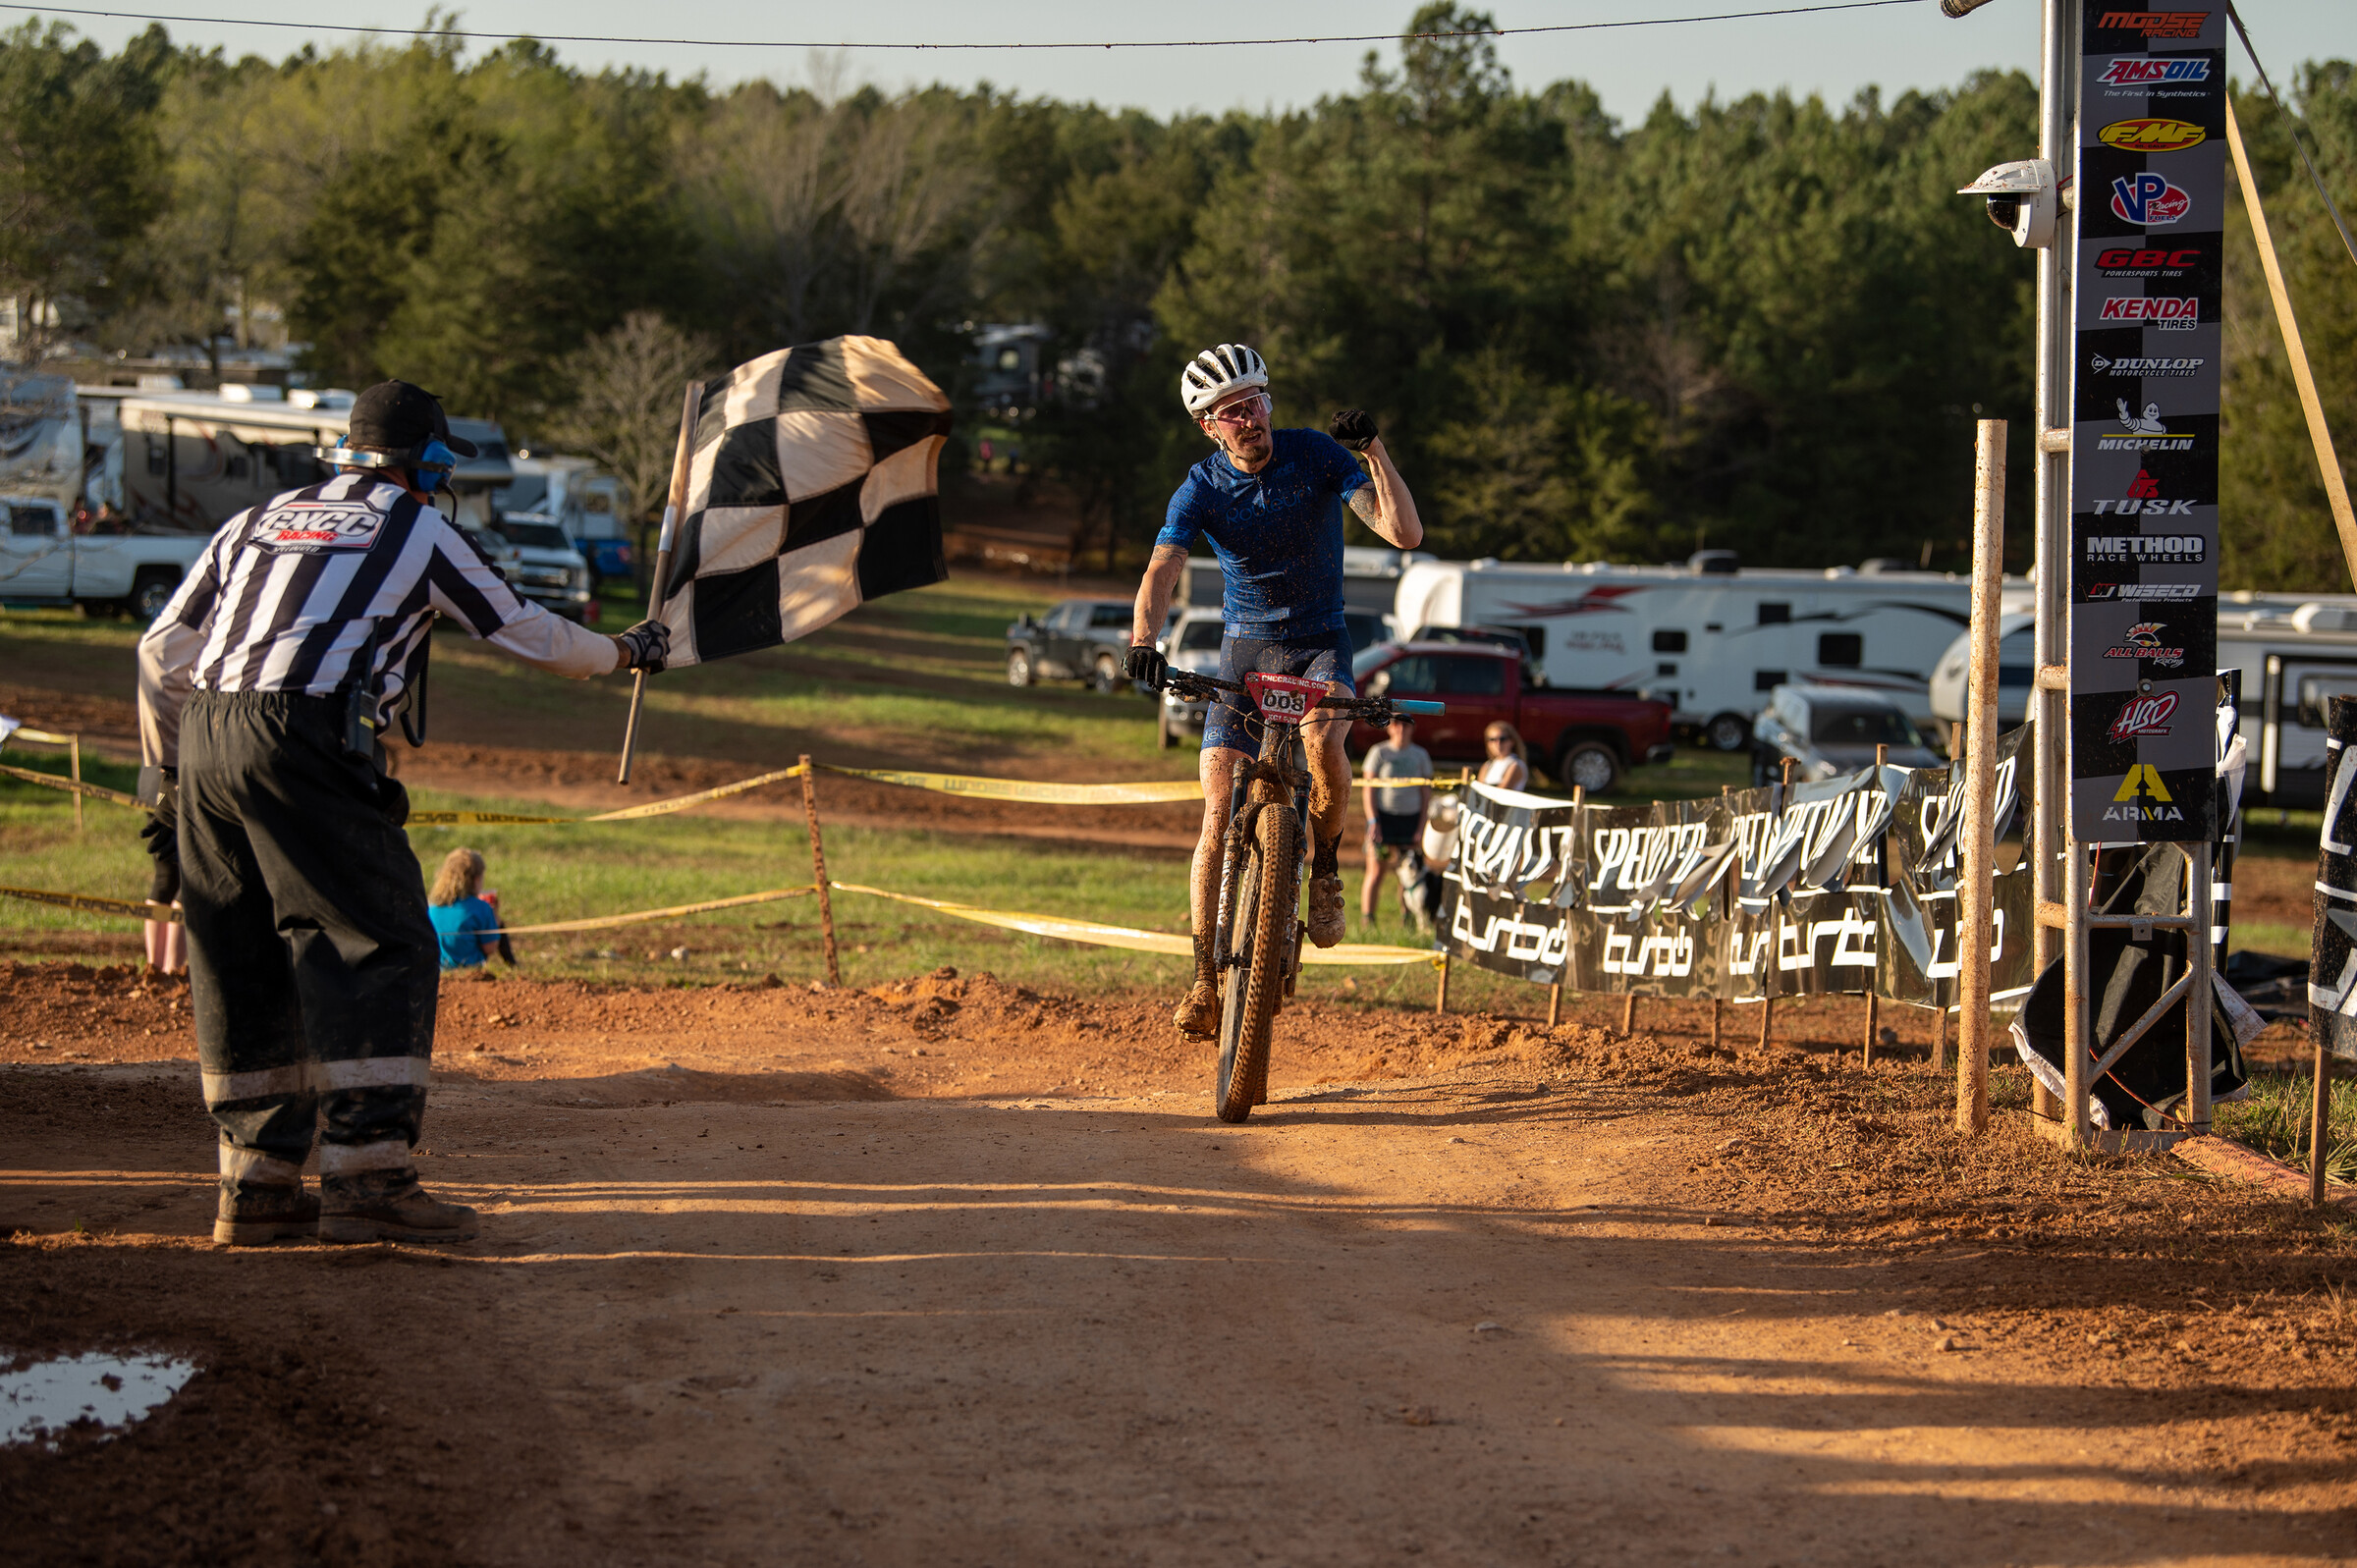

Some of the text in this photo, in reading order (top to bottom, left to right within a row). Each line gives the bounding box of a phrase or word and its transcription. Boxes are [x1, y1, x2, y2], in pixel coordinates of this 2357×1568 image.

[2098, 12, 2211, 28] MOOSE
[2140, 28, 2197, 37] RACING
[2102, 59, 2210, 83] AMSOIL
[2101, 123, 2206, 143] FMF
[2111, 173, 2167, 223] VP
[2149, 198, 2191, 214] Racing
[2097, 250, 2201, 267] GBC
[2100, 297, 2199, 320] KENDA
[2159, 319, 2197, 330] TIRES
[2111, 358, 2204, 369] DUNLOP
[2098, 439, 2193, 451] MICHELIN
[1226, 489, 1303, 524] Rouleur
[2093, 500, 2198, 515] TUSK
[257, 511, 379, 537] GNCC
[276, 530, 339, 541] RACING
[2087, 537, 2203, 553] METHOD
[2104, 648, 2183, 658] ALL BALLS
[2153, 657, 2183, 668] Racing
[1264, 691, 1304, 712] 008
[2102, 806, 2183, 821] ARMA
[1603, 924, 1693, 977] turbo
